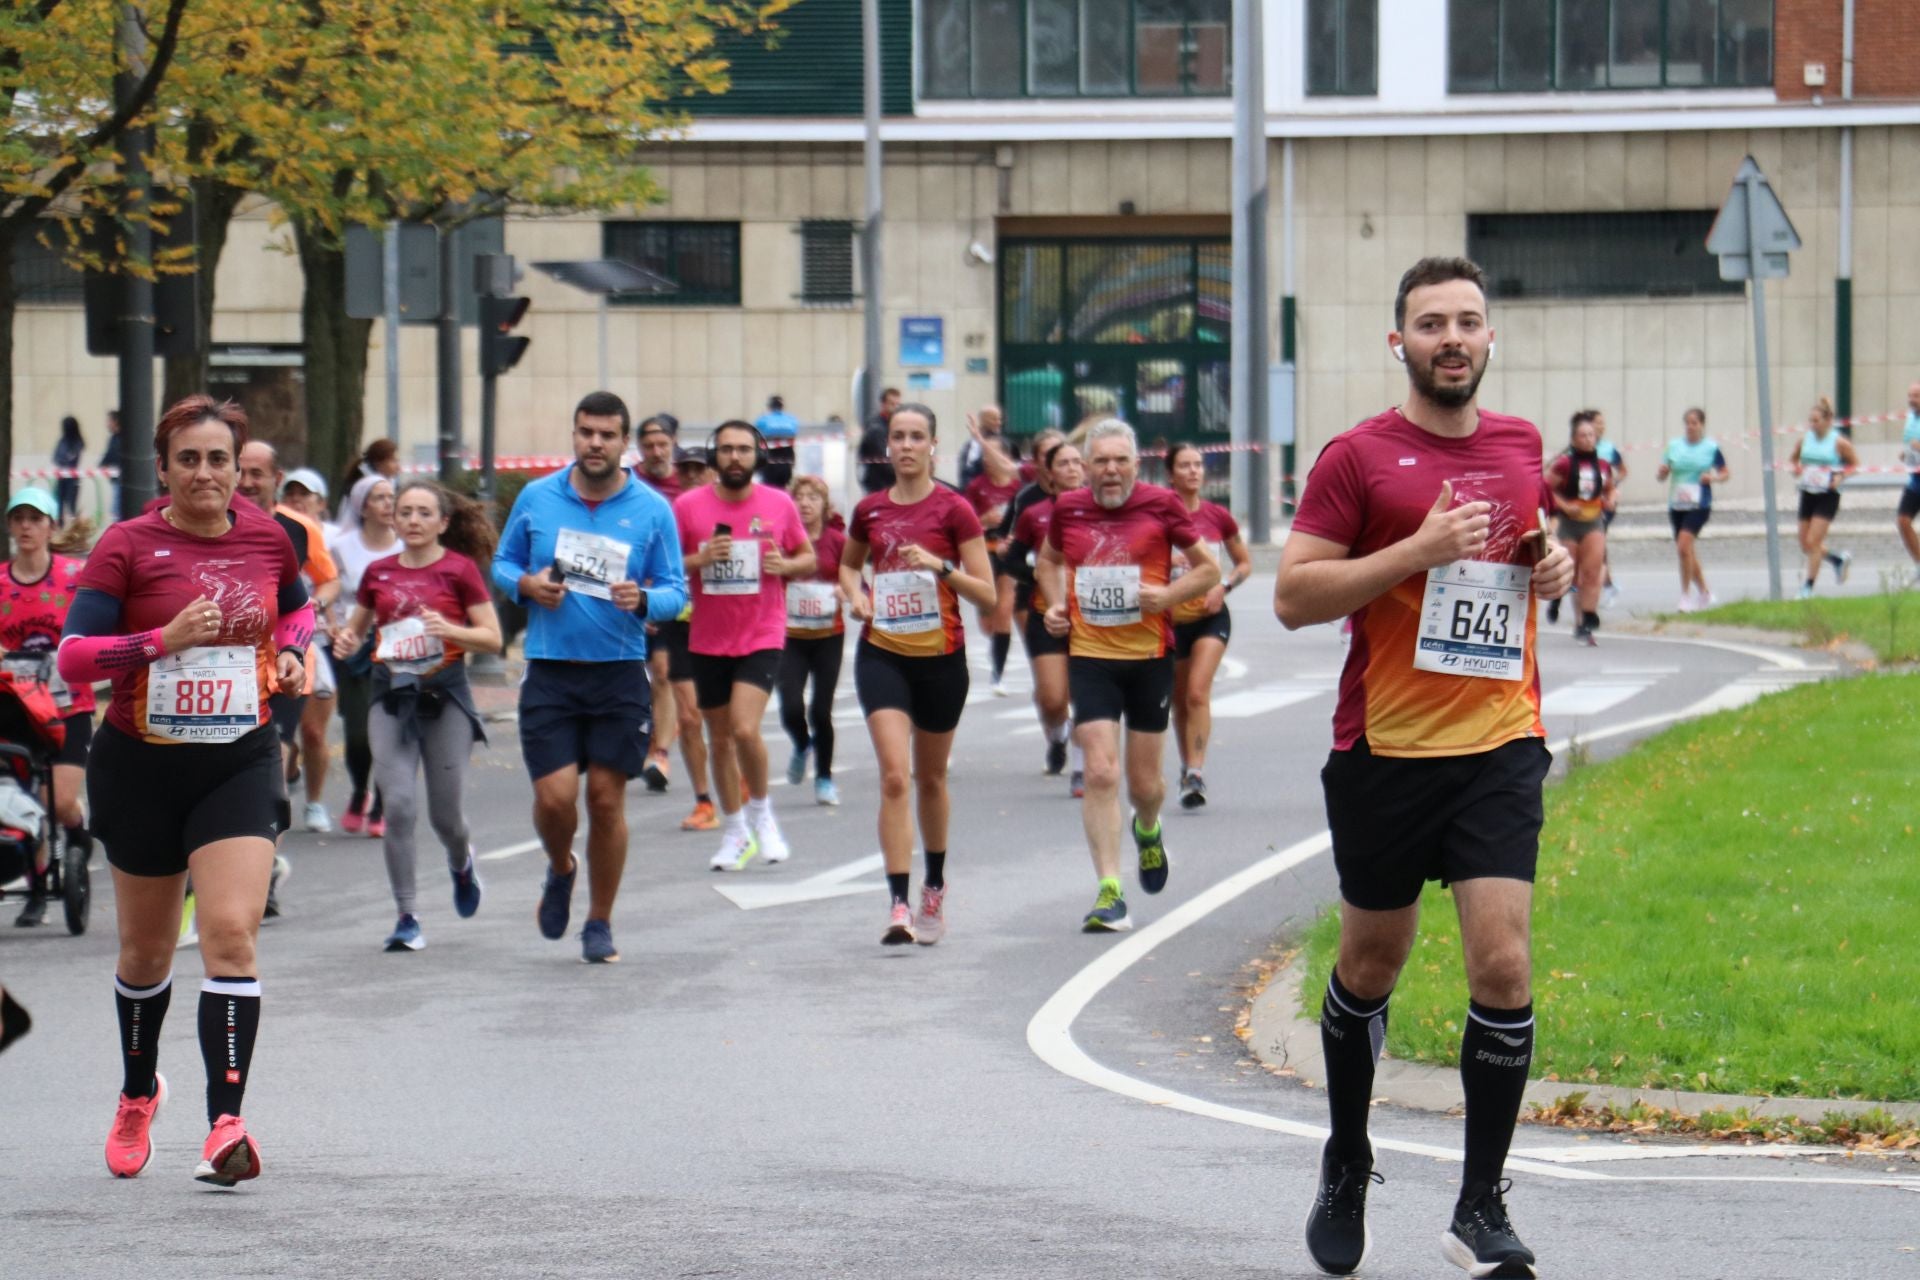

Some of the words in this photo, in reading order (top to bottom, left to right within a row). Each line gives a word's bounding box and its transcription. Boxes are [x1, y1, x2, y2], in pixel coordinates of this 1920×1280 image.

[570, 553, 608, 581] 524
[713, 559, 745, 579] 682
[886, 592, 922, 618] 855
[1089, 587, 1125, 609] 438
[1476, 590, 1498, 600] UVAS
[798, 599, 822, 616] 816
[1450, 599, 1510, 645] 643
[1463, 657, 1510, 671] HYUNDAI
[175, 679, 234, 715] 887
[189, 727, 241, 736] HYUNDAI
[227, 999, 236, 1068] COMPRESSPORT
[1474, 1048, 1528, 1068] SPORTLAST
